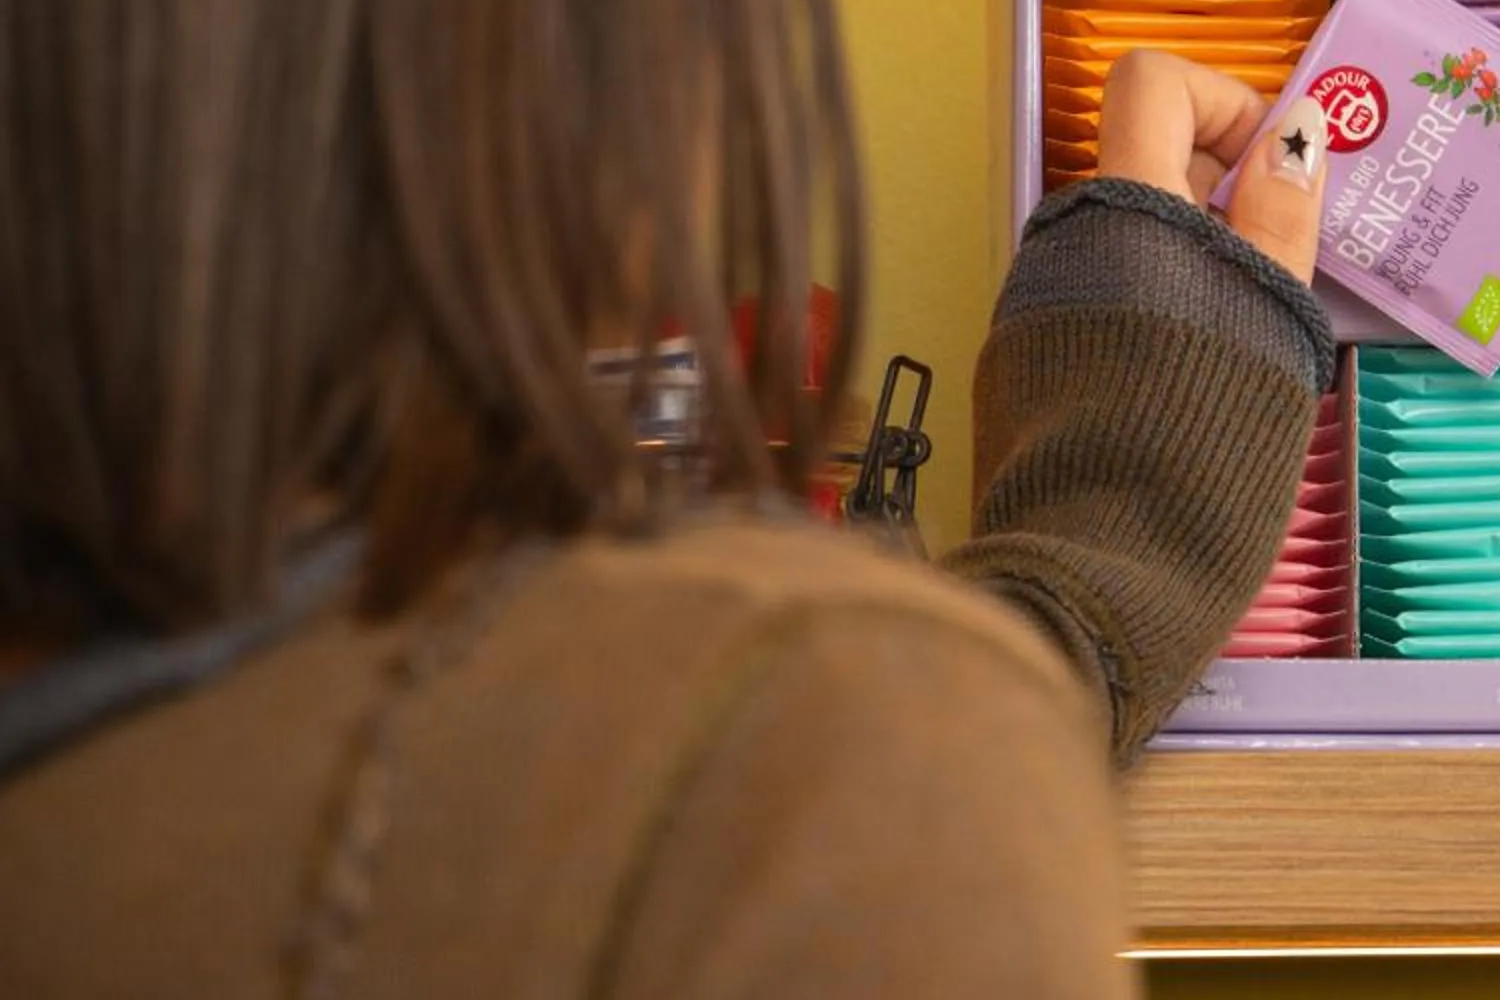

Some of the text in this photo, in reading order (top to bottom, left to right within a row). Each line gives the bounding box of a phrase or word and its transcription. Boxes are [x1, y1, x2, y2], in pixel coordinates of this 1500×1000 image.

[1313, 71, 1371, 102] ADOUR
[1337, 93, 1467, 270] BENESSERE
[1349, 155, 1380, 190] BIO
[1375, 227, 1422, 281] YOUNG
[1420, 183, 1447, 215] FIT
[1421, 215, 1457, 258] DICH
[1444, 175, 1481, 221] JUNG
